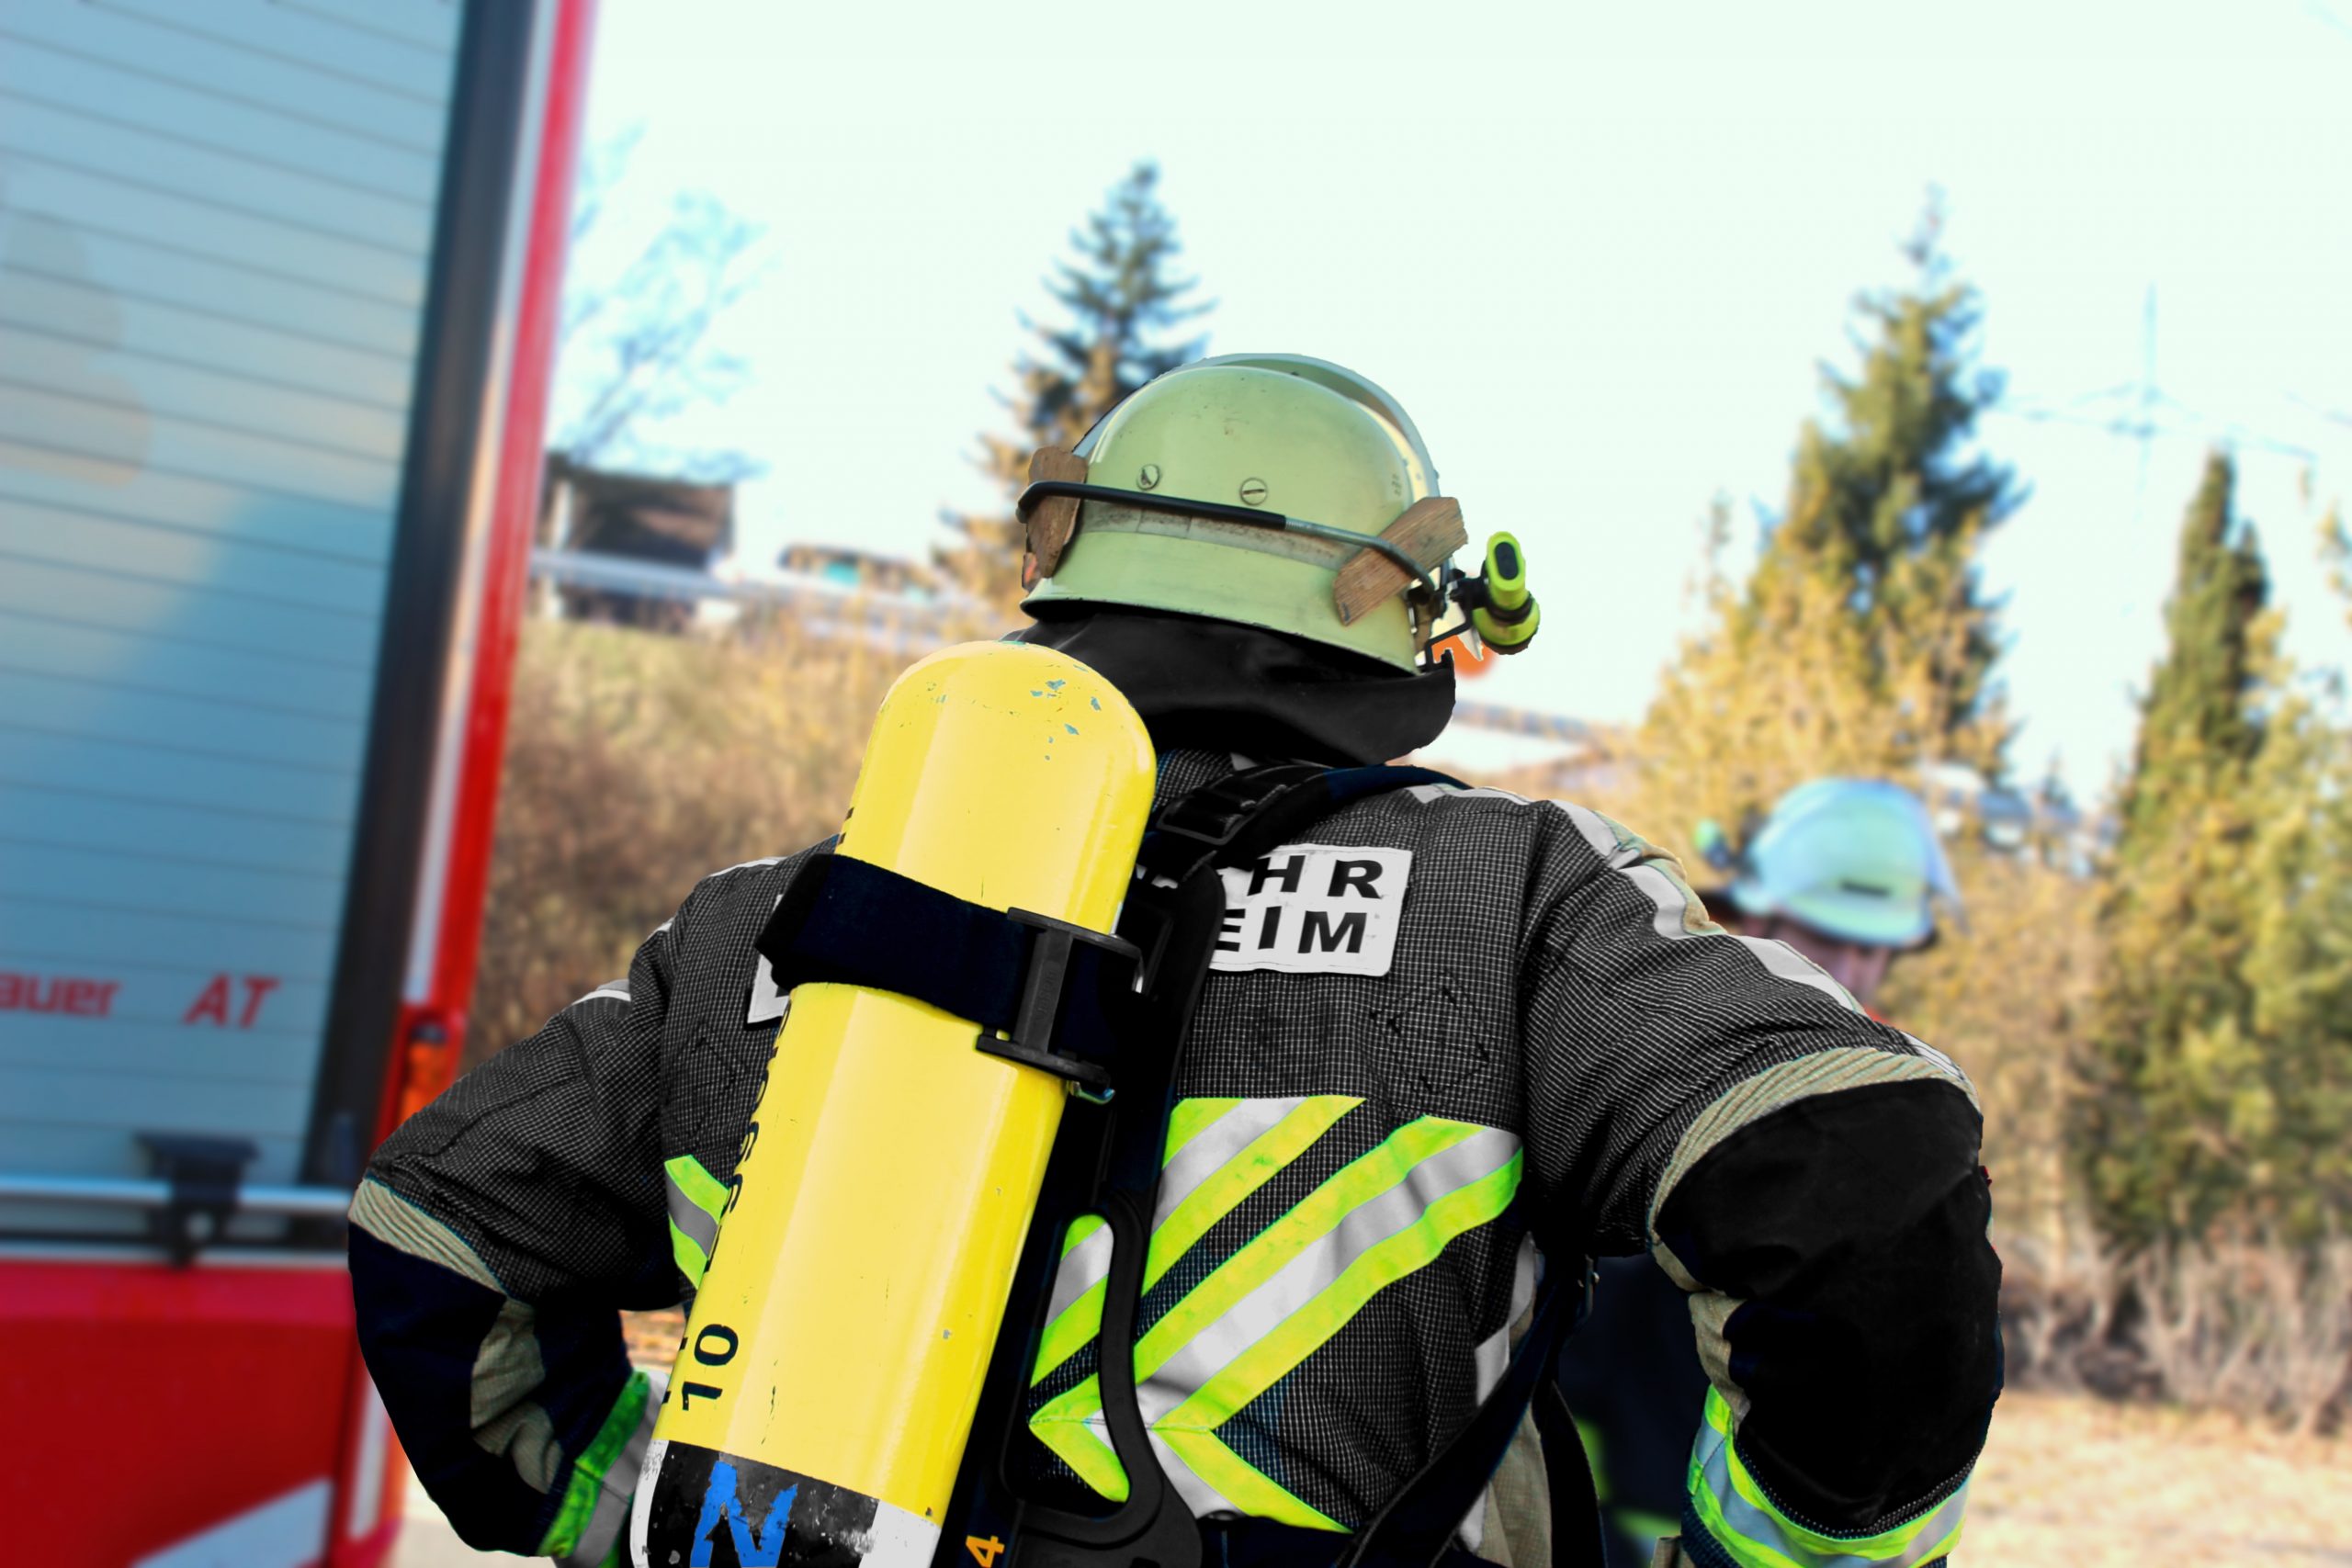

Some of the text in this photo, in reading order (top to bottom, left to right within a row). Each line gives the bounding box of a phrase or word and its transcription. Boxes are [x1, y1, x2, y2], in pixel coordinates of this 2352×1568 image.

[1247, 854, 1383, 899] HR
[183, 972, 281, 1030] AT
[681, 1323, 739, 1411] 10
[966, 1534, 1005, 1568] 4
